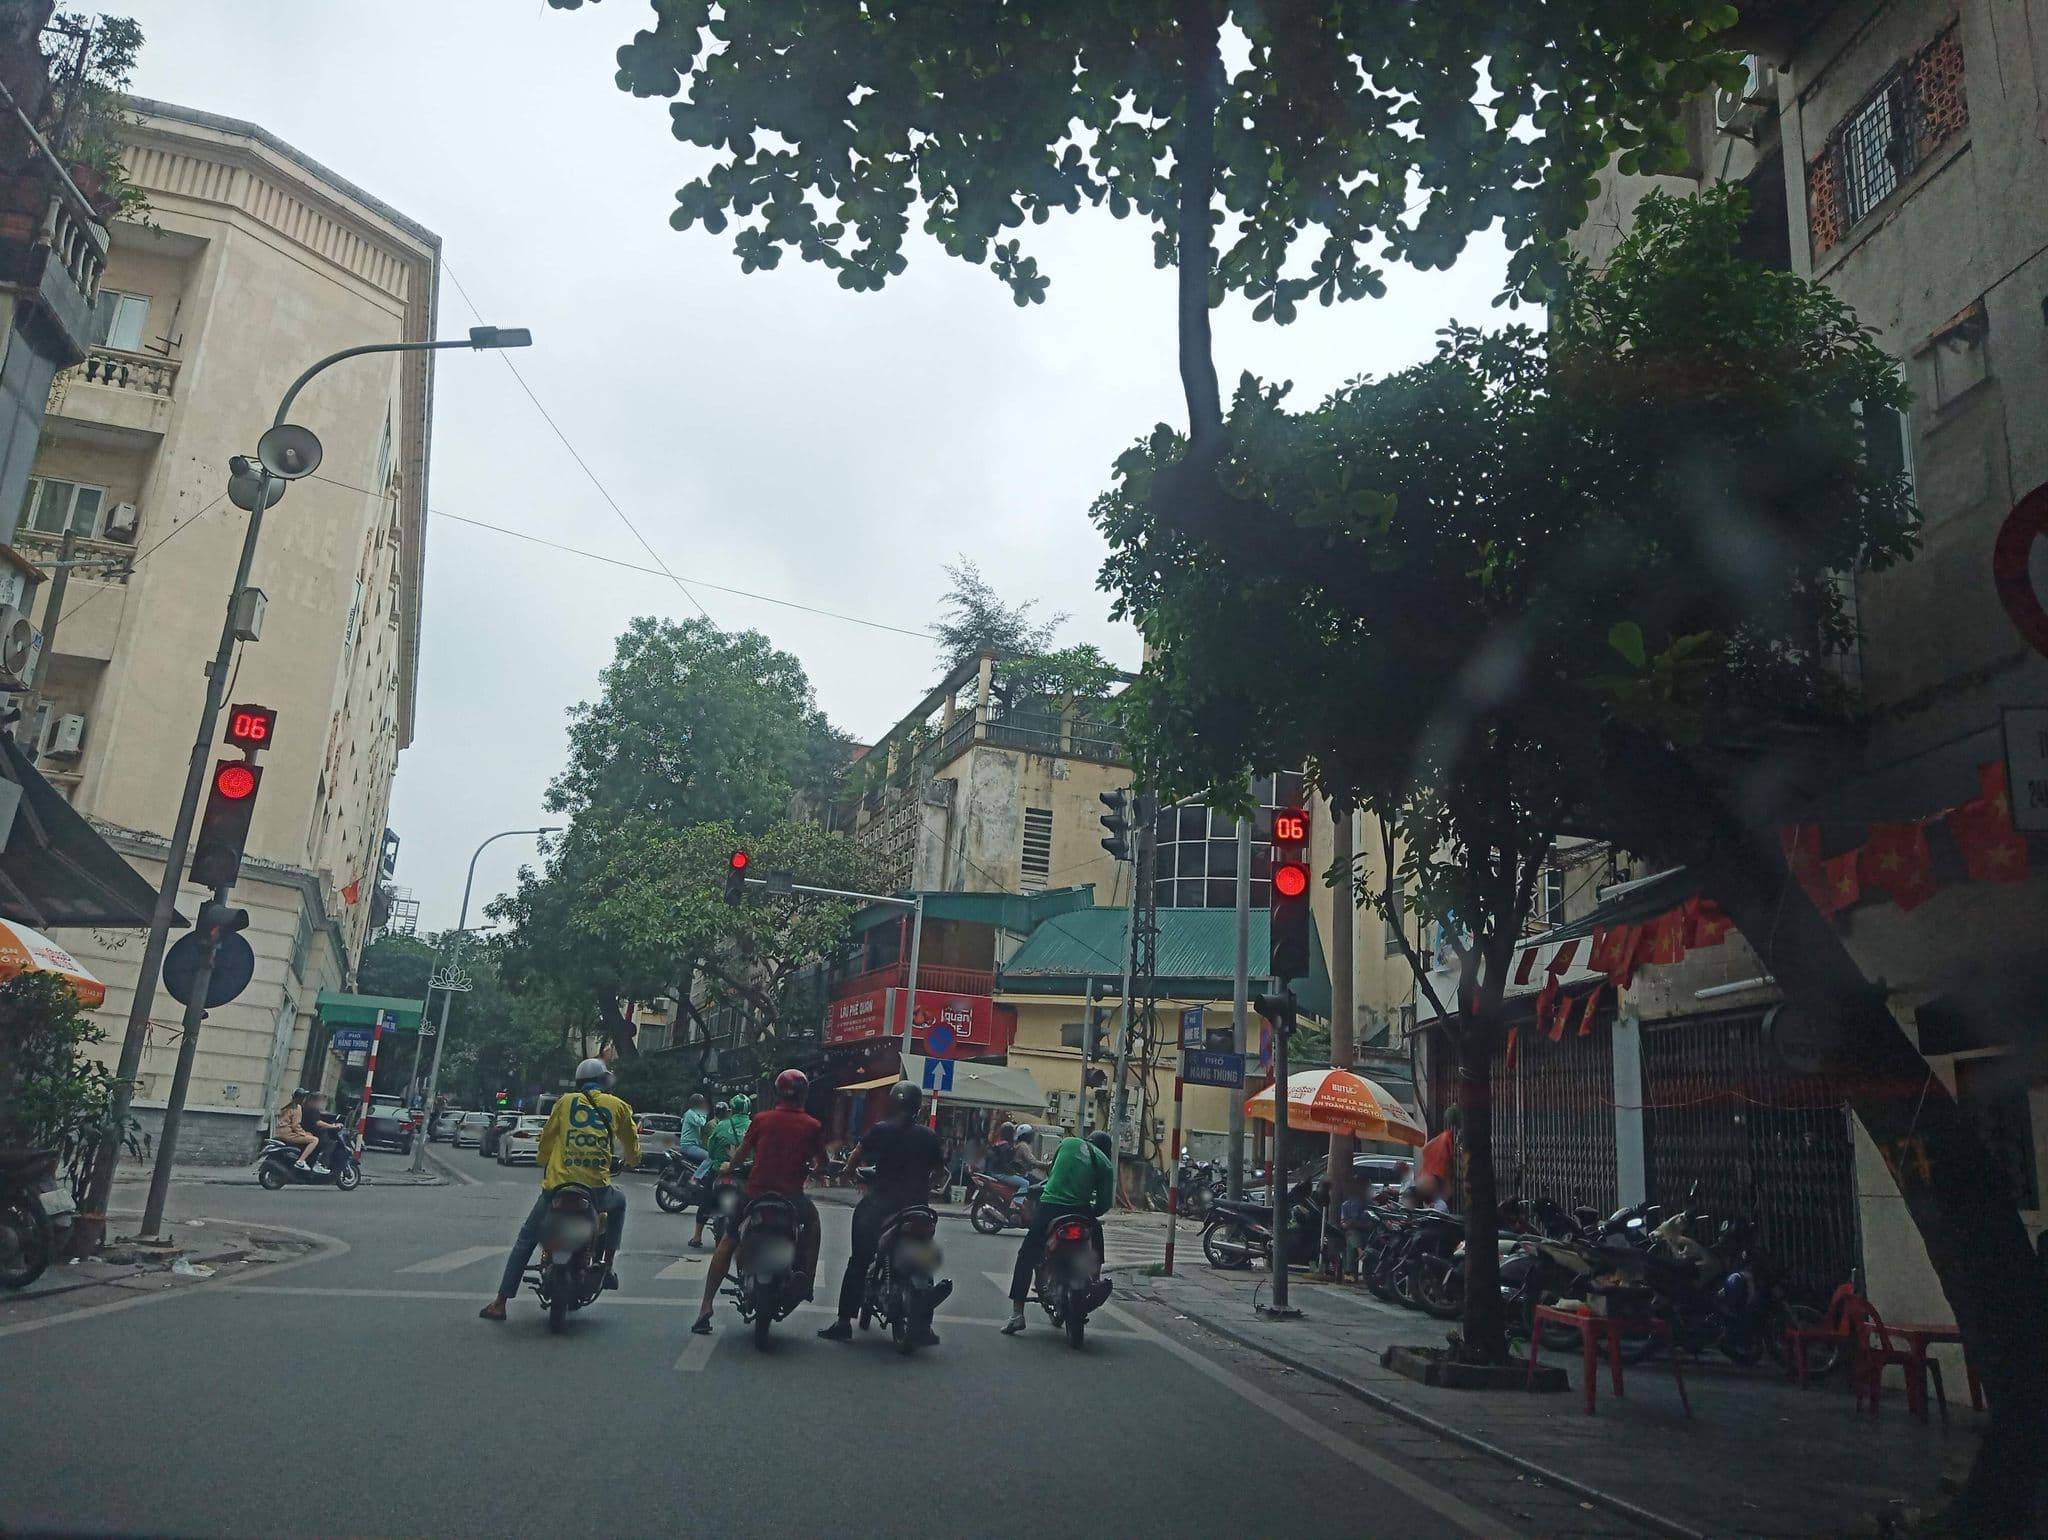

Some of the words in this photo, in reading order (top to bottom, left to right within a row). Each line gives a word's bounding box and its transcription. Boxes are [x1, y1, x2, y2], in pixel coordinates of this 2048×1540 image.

[235, 714, 267, 739] 06
[1278, 818, 1304, 839] 06
[1205, 1056, 1224, 1066] PHỐ
[570, 1096, 612, 1130] be
[566, 1129, 609, 1148] Food
